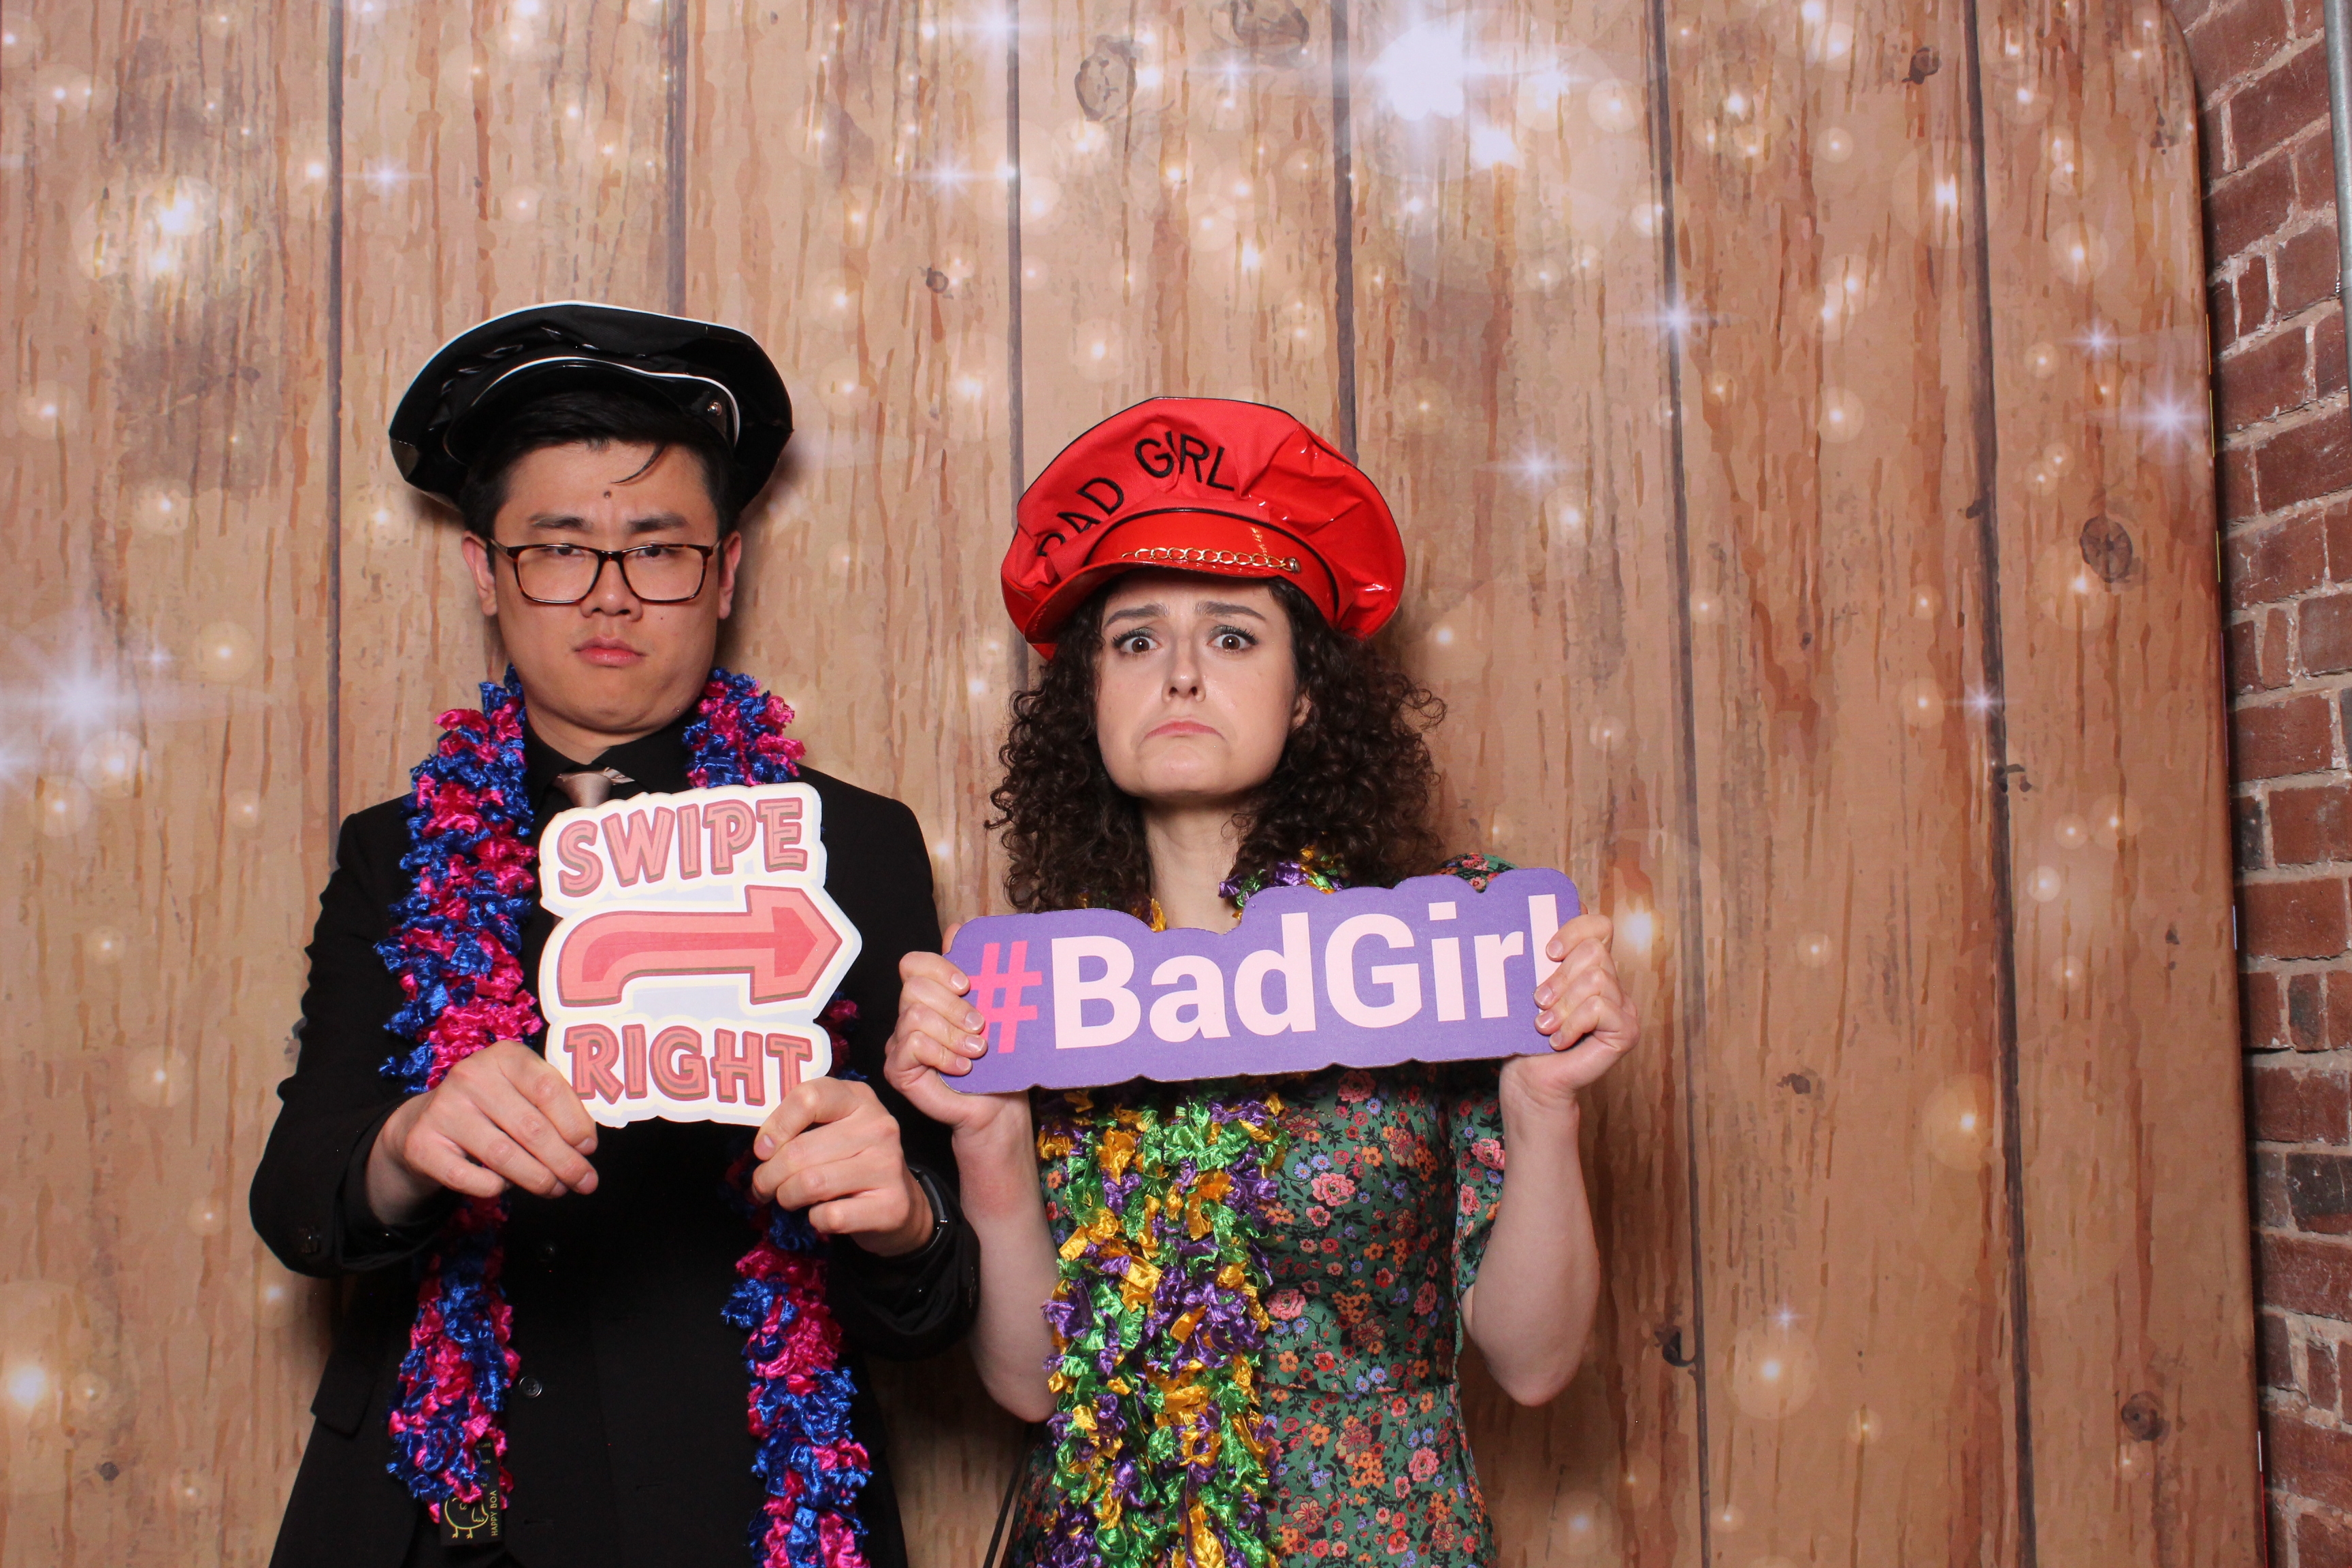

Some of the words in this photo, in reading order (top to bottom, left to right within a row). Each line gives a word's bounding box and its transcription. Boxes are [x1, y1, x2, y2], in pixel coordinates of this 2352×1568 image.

[557, 797, 808, 898] SWIPE
[967, 894, 1562, 1054] #BadGirl
[564, 1024, 813, 1107] RIGHT
[489, 1490, 497, 1509] BOA
[490, 1511, 498, 1537] HAPPY
